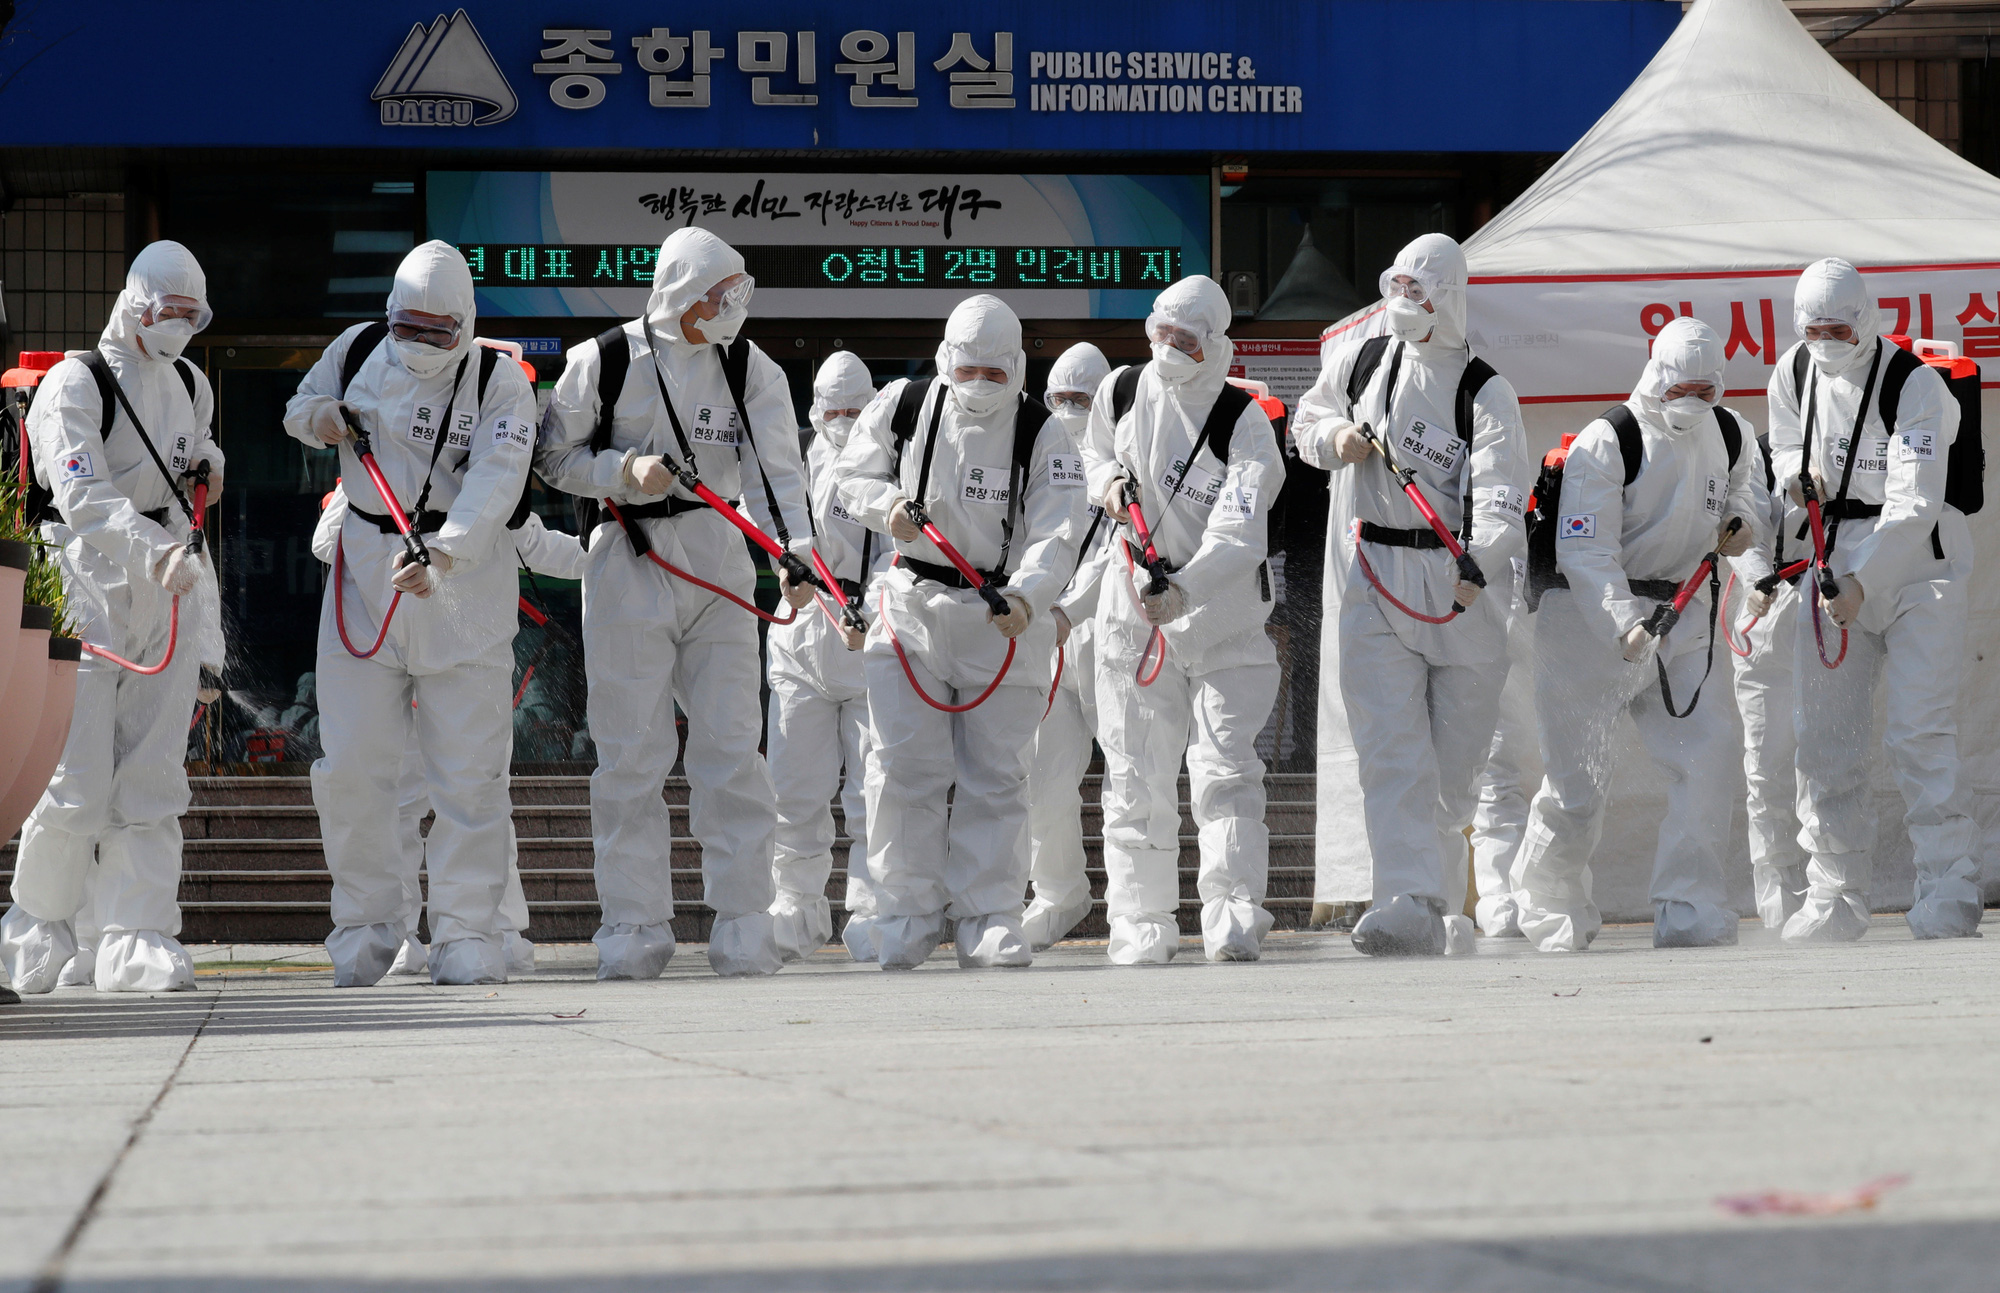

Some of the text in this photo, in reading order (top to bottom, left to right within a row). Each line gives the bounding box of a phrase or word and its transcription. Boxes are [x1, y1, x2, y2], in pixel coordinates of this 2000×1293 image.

[533, 28, 1016, 108] 종합민원실
[1030, 51, 1256, 80] PUBLIC SERVICE &
[1030, 83, 1302, 113] INFORMATION CENTER
[381, 101, 473, 126] DAEGU
[639, 186, 727, 227] 행복한
[732, 179, 801, 219] 시민
[918, 184, 1002, 240] 대구
[849, 220, 868, 228] Happy
[870, 219, 893, 227] Citizens
[921, 220, 940, 228] Daegu
[504, 247, 575, 280] 대표
[944, 249, 996, 282] 2명
[1016, 249, 1121, 283] 인건비
[1140, 249, 1181, 283] 지
[520, 341, 559, 351] 원발급기
[416, 406, 474, 432] 육 군
[698, 408, 712, 425] 육
[412, 425, 471, 447] 현장 원팀
[518, 423, 530, 437] 군
[694, 427, 735, 443] 현장 지원팀
[1411, 421, 1462, 456] 육 군
[1922, 434, 1932, 447] 군
[1402, 436, 1454, 470] 현장 지원팀
[1913, 446, 1933, 456] 지원팀
[1052, 458, 1082, 472] 육 군
[1857, 458, 1887, 471] 지원팀
[969, 468, 985, 485] 육
[1052, 472, 1066, 480] 현장
[965, 486, 1010, 501] 현장 지원
[1206, 478, 1223, 494] 군
[1184, 486, 1217, 506] 지원팀
[1242, 492, 1253, 504] 군
